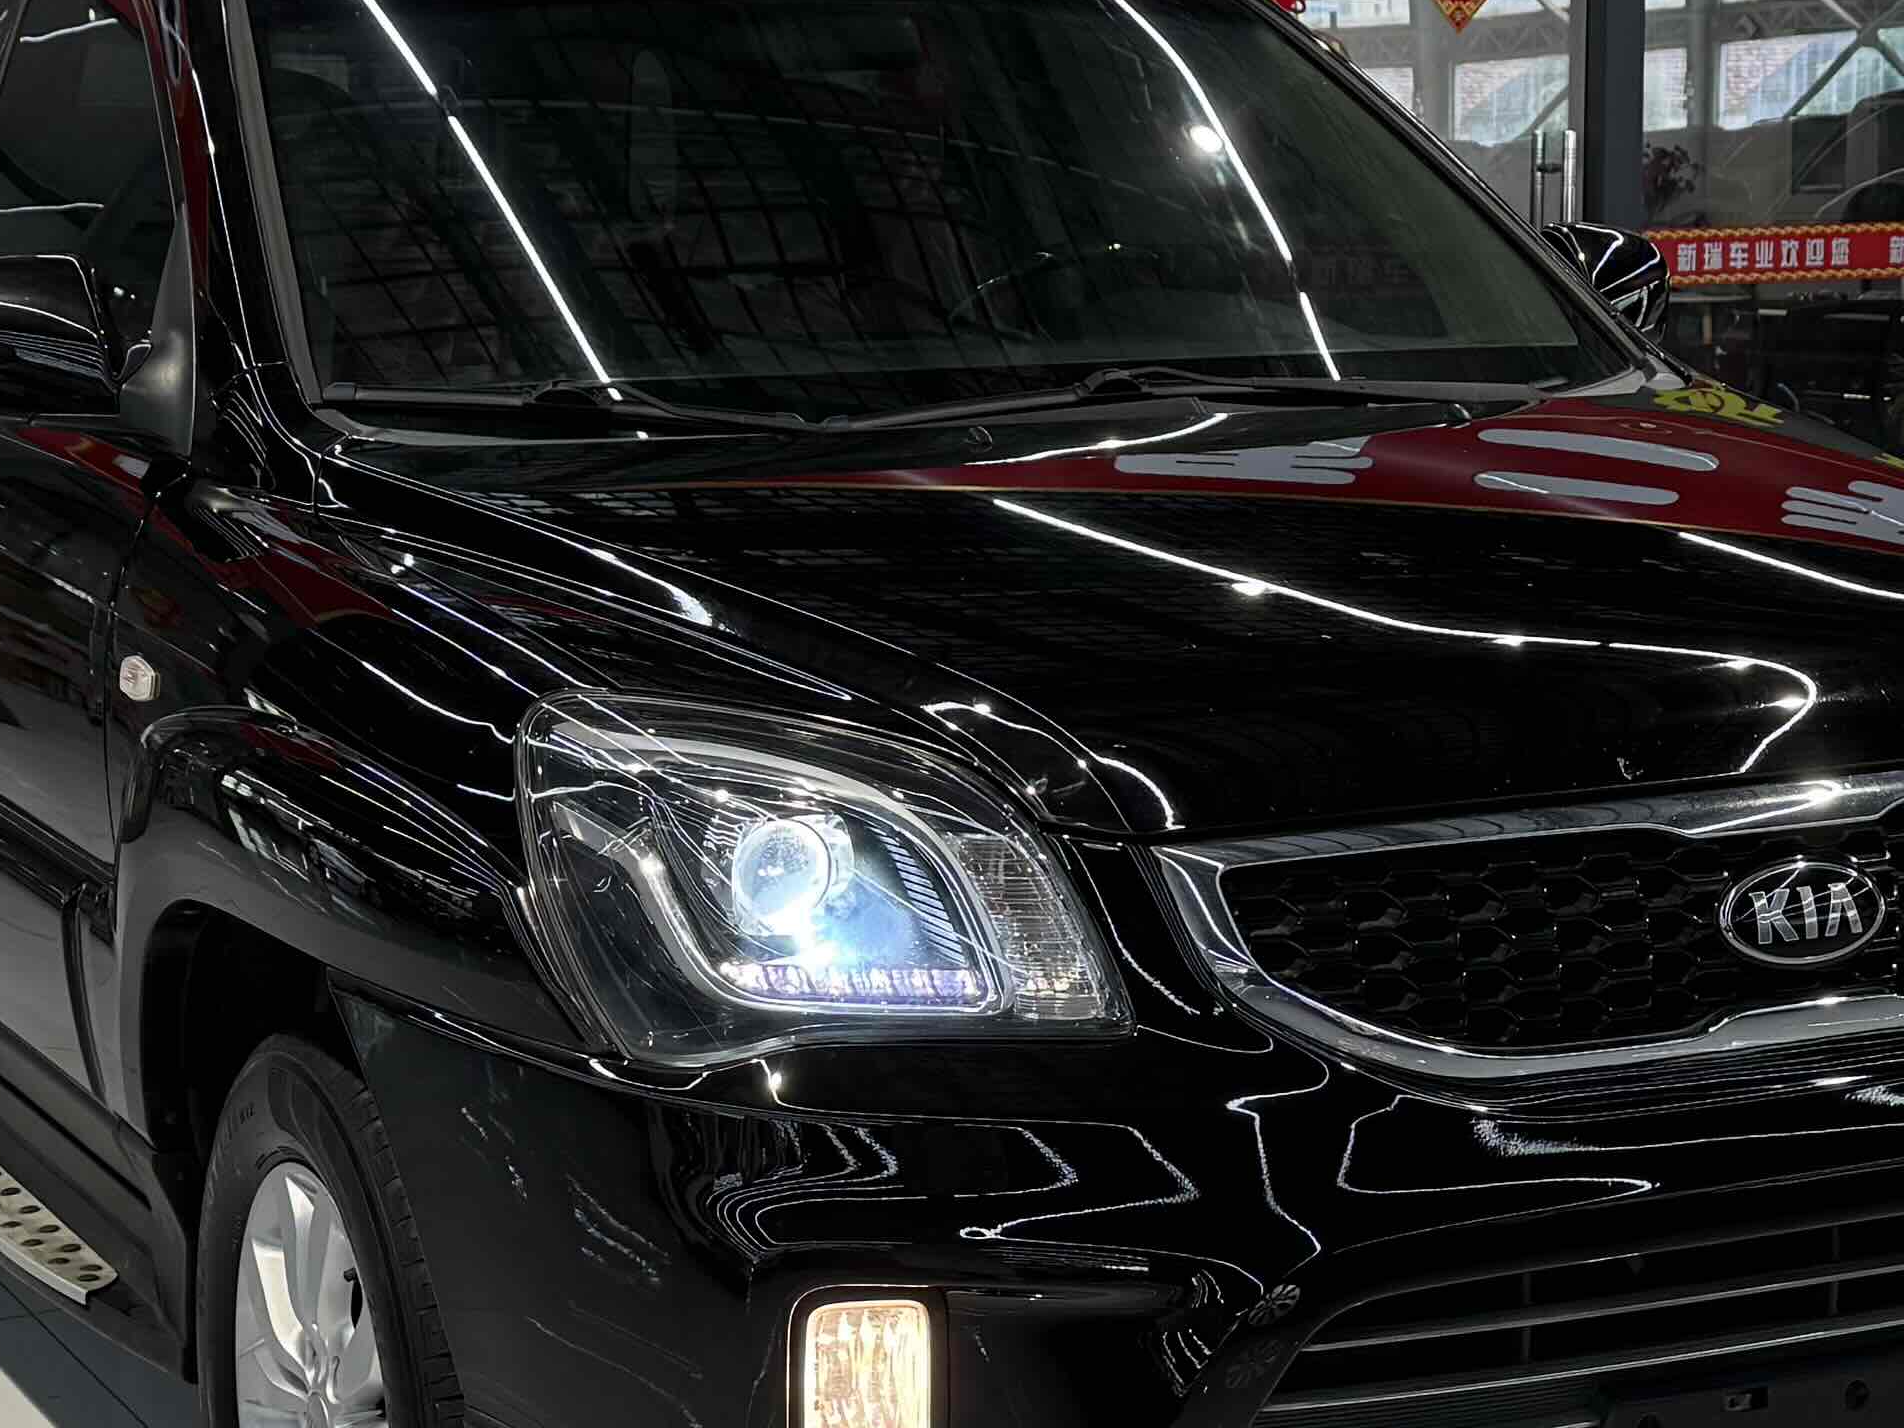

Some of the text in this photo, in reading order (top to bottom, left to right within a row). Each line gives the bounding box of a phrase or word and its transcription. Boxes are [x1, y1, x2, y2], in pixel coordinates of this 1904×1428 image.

[1676, 236, 1852, 272] 新瑞车业欢迎您
[1748, 882, 1863, 945] KIA
